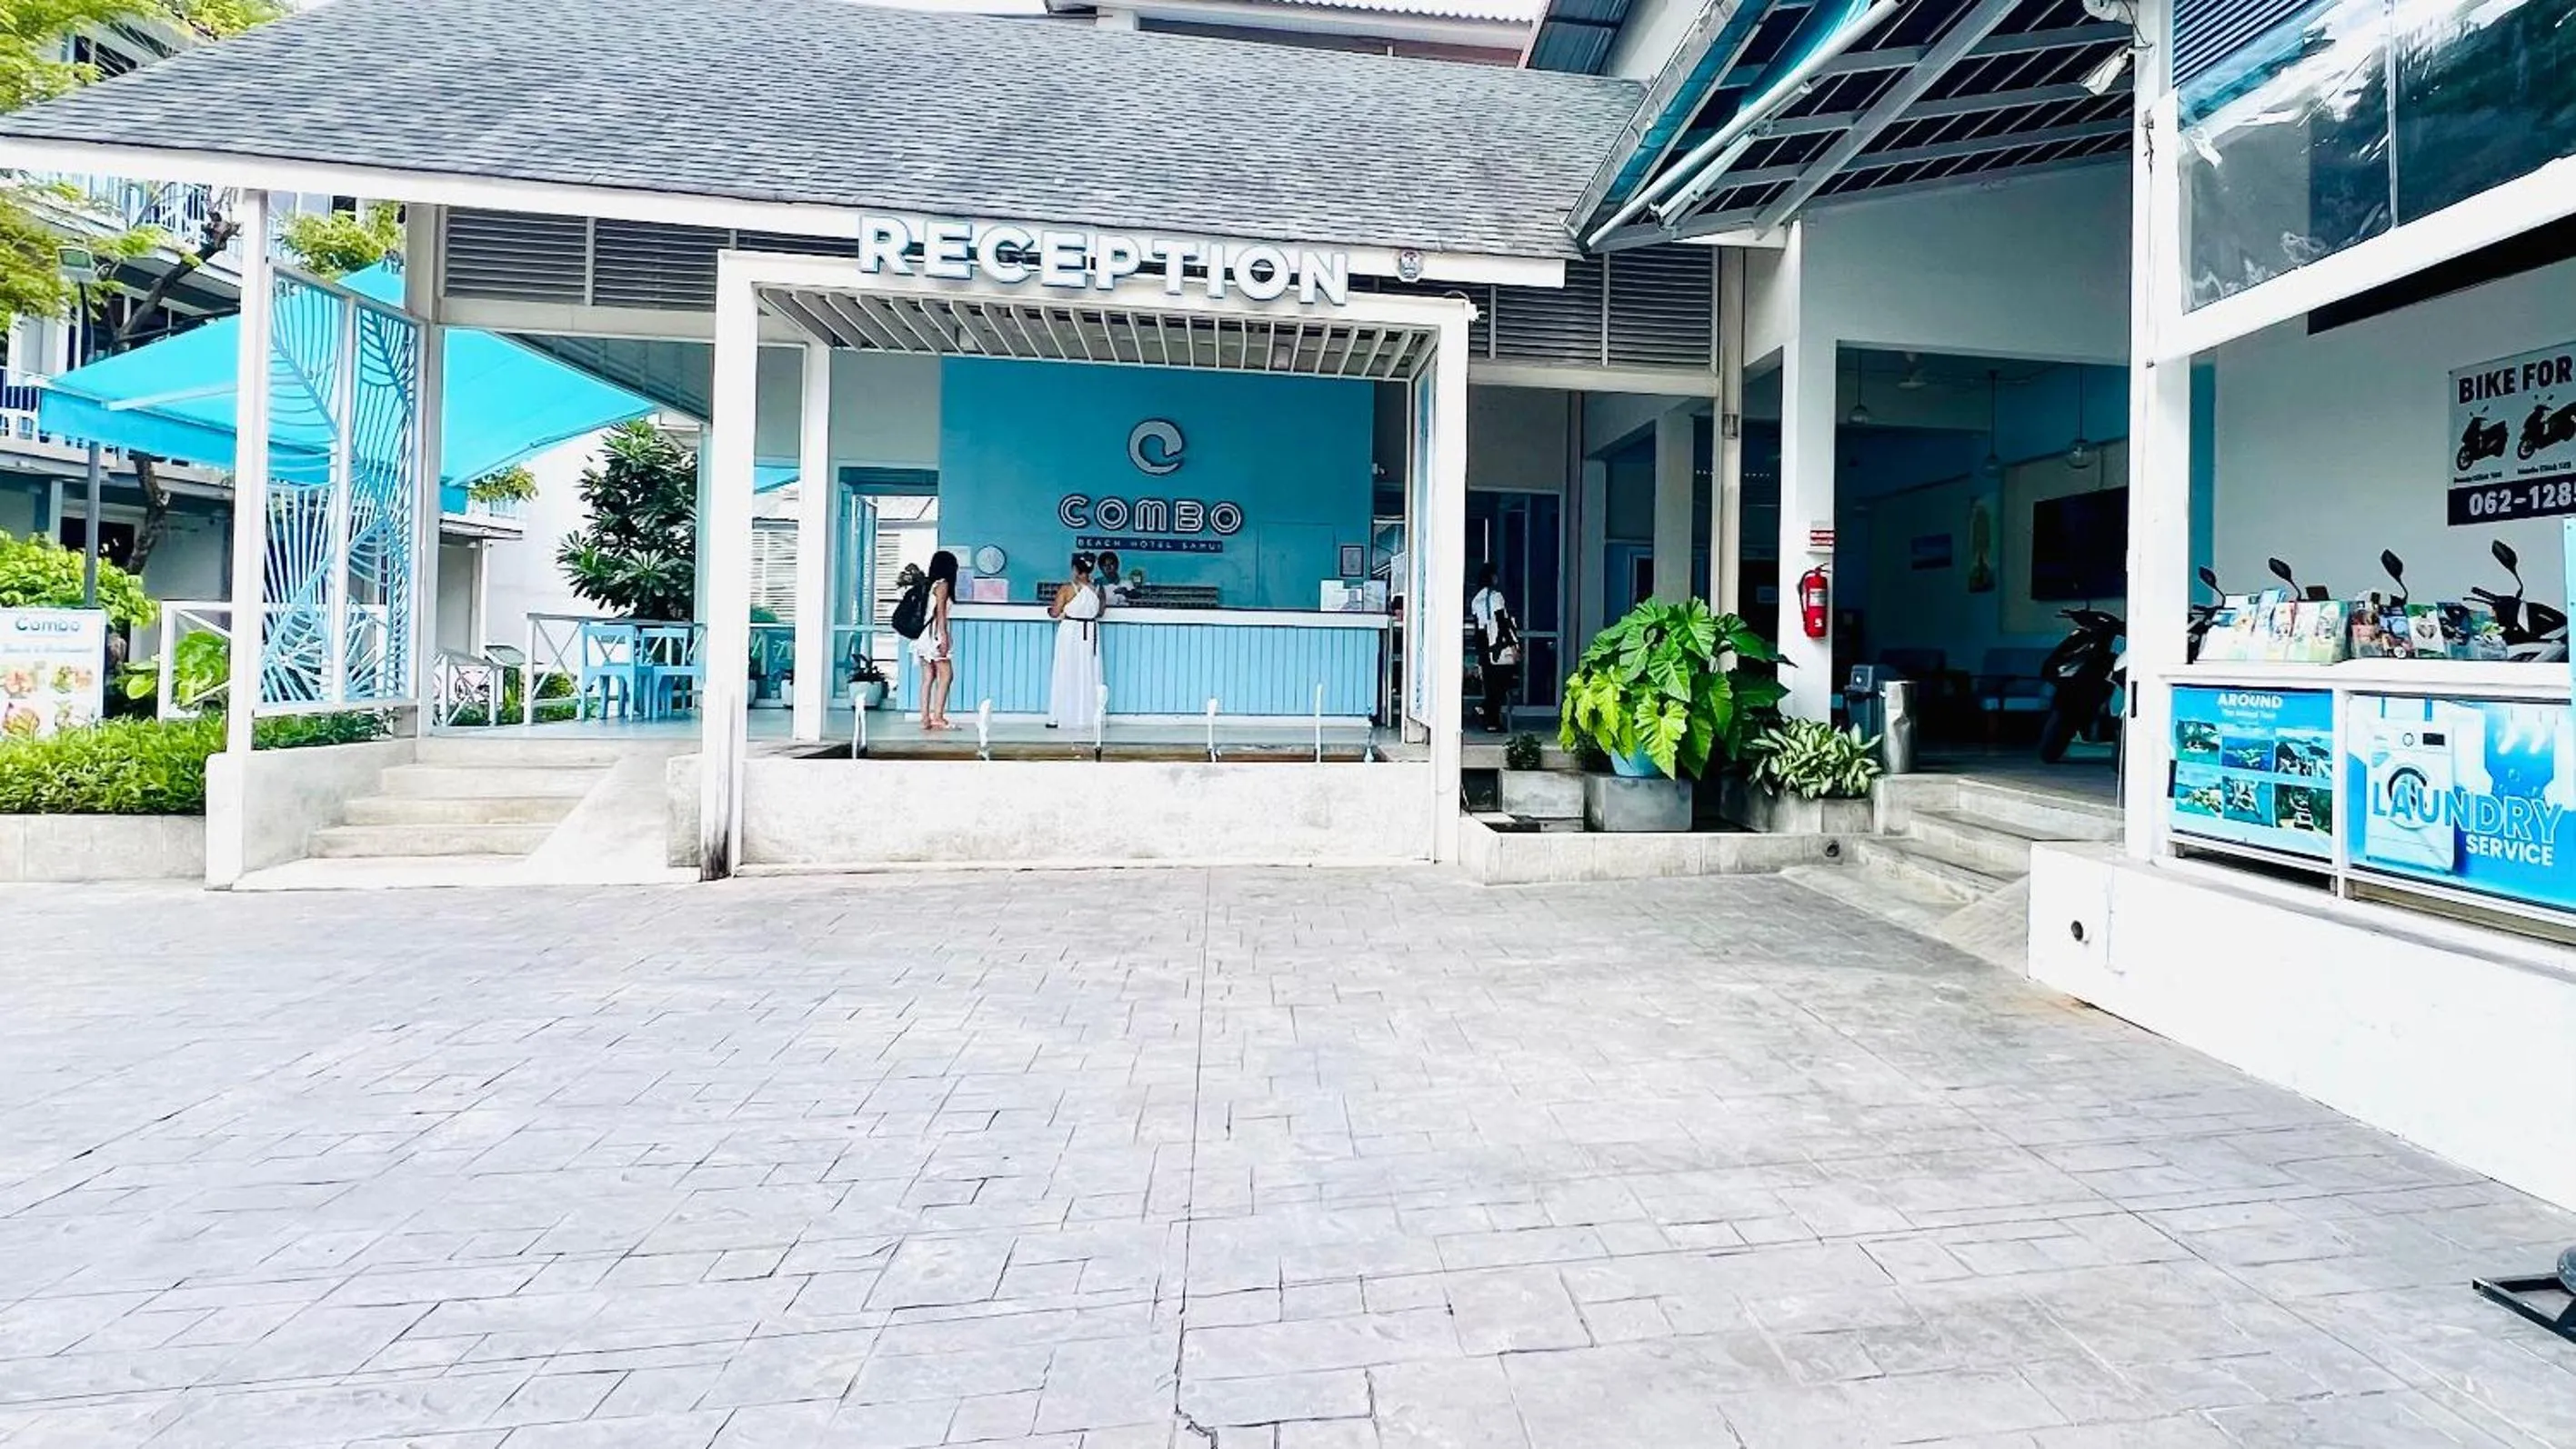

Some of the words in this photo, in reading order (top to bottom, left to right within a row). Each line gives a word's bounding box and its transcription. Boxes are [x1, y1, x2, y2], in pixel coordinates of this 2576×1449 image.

[858, 215, 1348, 306] RECEPTION
[2458, 367, 2517, 404] BIKE
[2522, 355, 2573, 391] FOR
[1058, 494, 1244, 535] COMBO
[2469, 482, 2576, 516] 062-128
[1077, 538, 1121, 547] BEACH
[1130, 539, 1173, 549] HOTEL
[2217, 693, 2283, 709] AROUND
[2371, 782, 2563, 844] LAUNDRY
[2465, 834, 2554, 867] SERVICE
